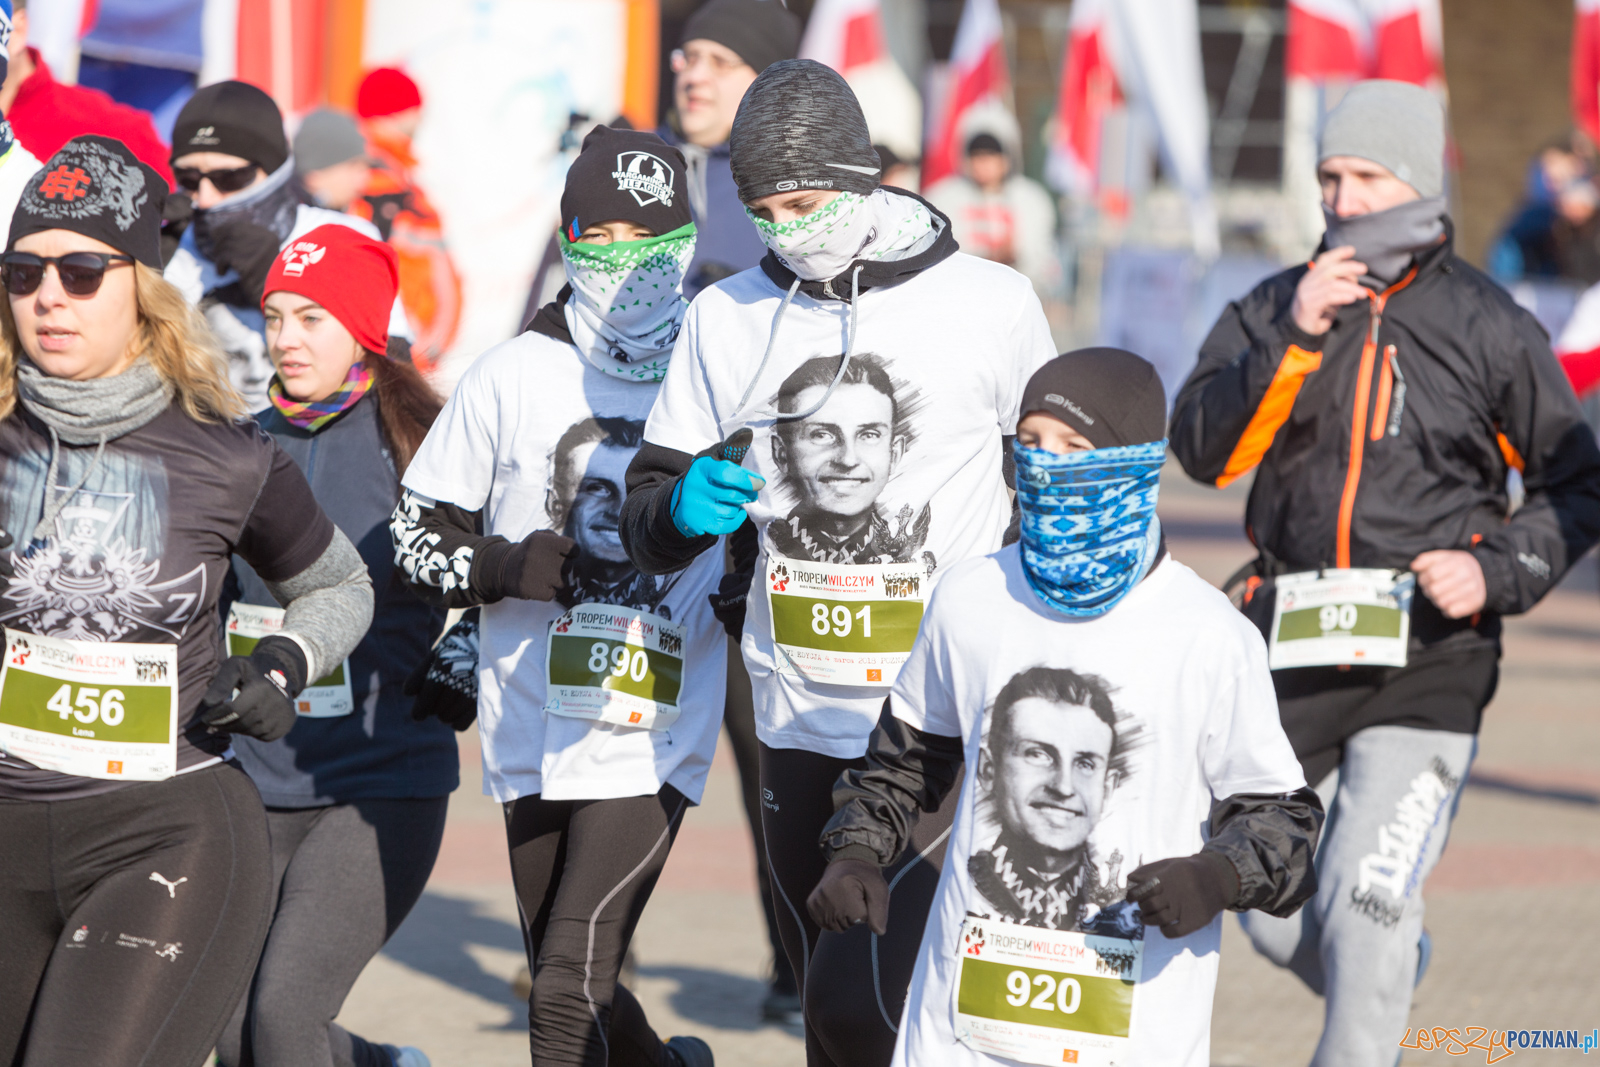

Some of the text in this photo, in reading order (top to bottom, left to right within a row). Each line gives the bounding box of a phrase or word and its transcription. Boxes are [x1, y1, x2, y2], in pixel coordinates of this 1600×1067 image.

[627, 180, 663, 198] LEAGUE
[801, 179, 834, 188] Kalenji
[1062, 398, 1095, 426] Kalenji
[792, 570, 875, 588] TROPEMWILCZYM
[576, 612, 654, 635] TROPEMWILCZYM
[811, 603, 872, 638] 891
[1319, 603, 1358, 631] 90
[35, 644, 126, 667] TROPEMWILCZYM
[588, 642, 649, 682] 890
[797, 651, 822, 661] EDYCJA
[858, 657, 876, 665] 2018
[881, 656, 907, 665] POZNA
[47, 684, 126, 726] 456
[72, 727, 95, 737] Lena
[989, 933, 1085, 958] TROPEMWILCZYM
[1005, 970, 1082, 1014] 920
